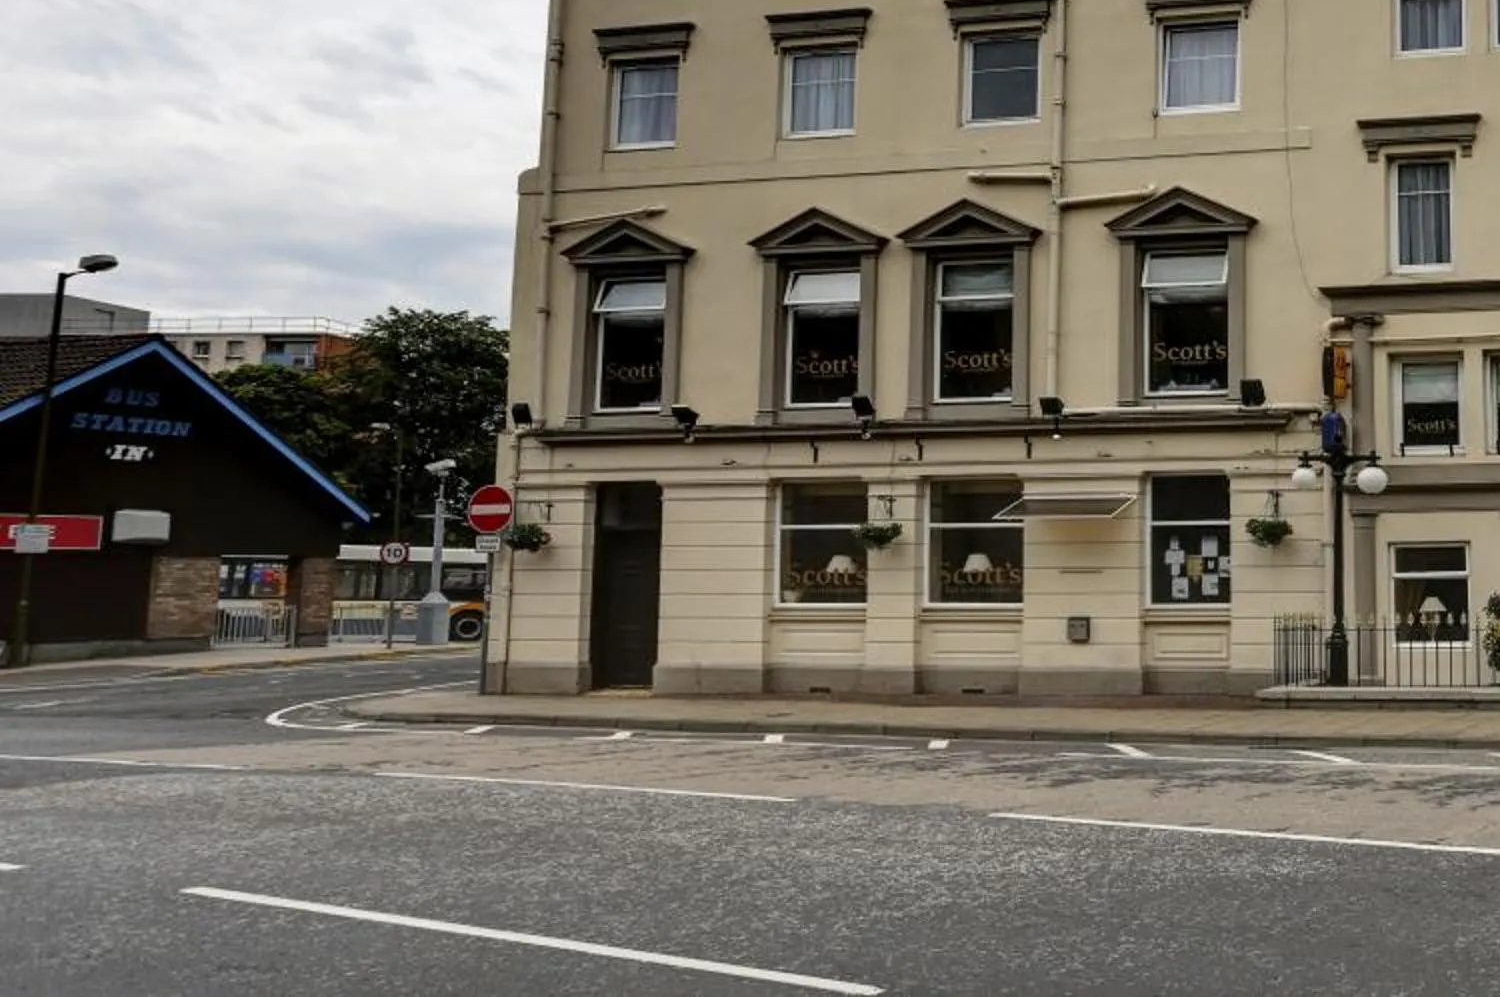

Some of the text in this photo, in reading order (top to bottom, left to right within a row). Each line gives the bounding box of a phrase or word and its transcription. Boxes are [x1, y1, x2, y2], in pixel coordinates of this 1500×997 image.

[943, 349, 1012, 369] Scott's
[1152, 339, 1227, 361] Scott's
[105, 387, 160, 407] BUS
[70, 412, 192, 437] STATION
[110, 444, 148, 462] IN
[387, 547, 403, 558] 10
